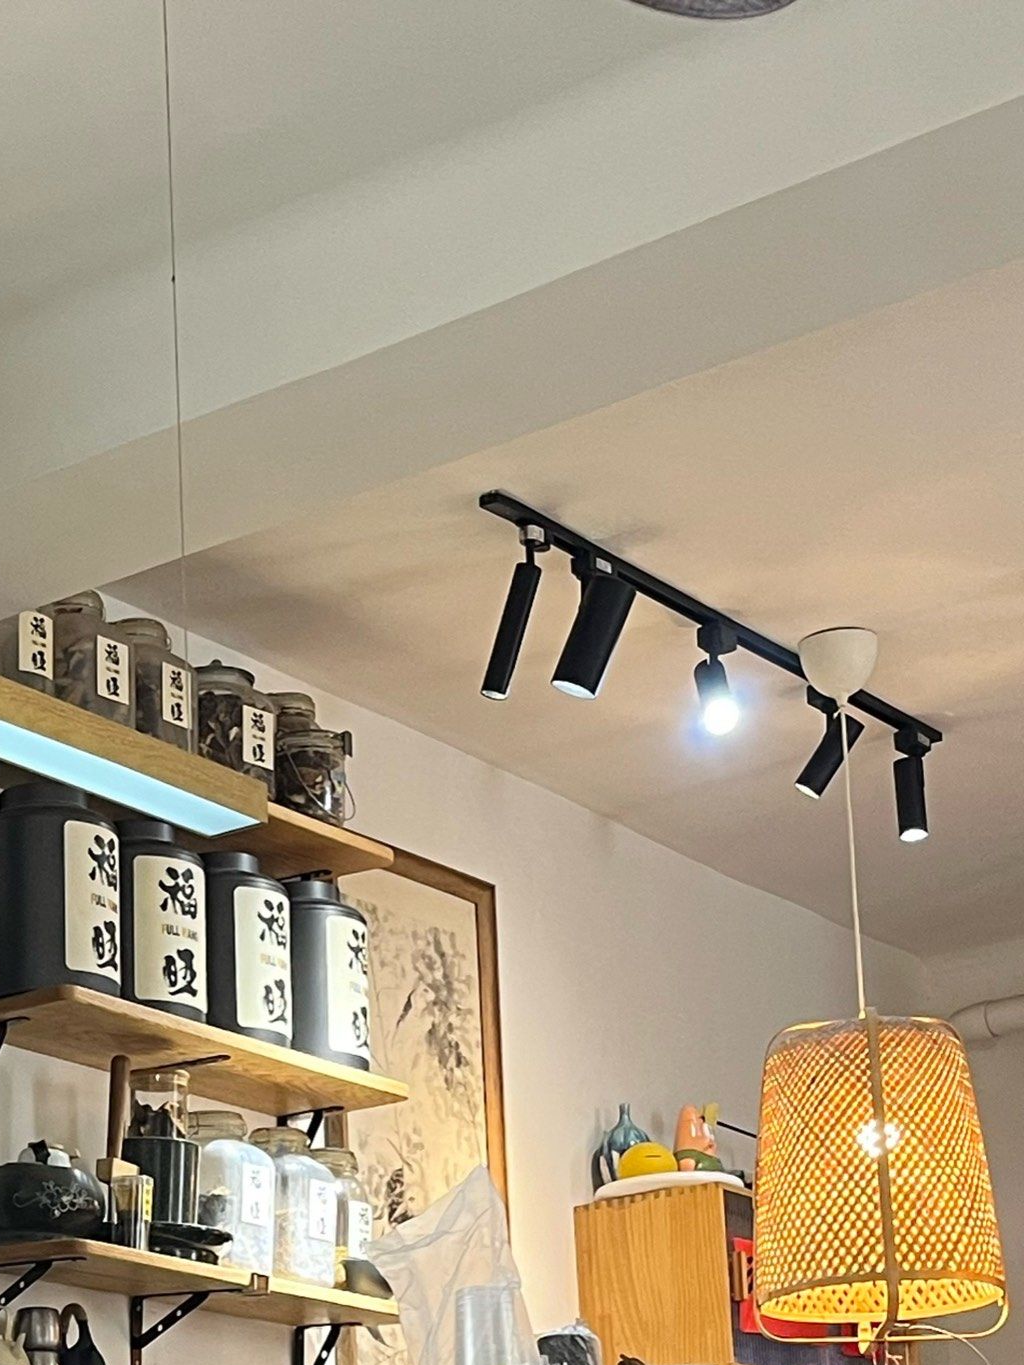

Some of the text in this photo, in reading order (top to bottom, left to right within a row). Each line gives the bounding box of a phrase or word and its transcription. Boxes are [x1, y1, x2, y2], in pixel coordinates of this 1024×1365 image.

[88, 834, 118, 892] 福
[158, 867, 197, 919] 福
[91, 921, 118, 973] 旺
[258, 900, 286, 949] 福
[162, 949, 197, 997] 旺
